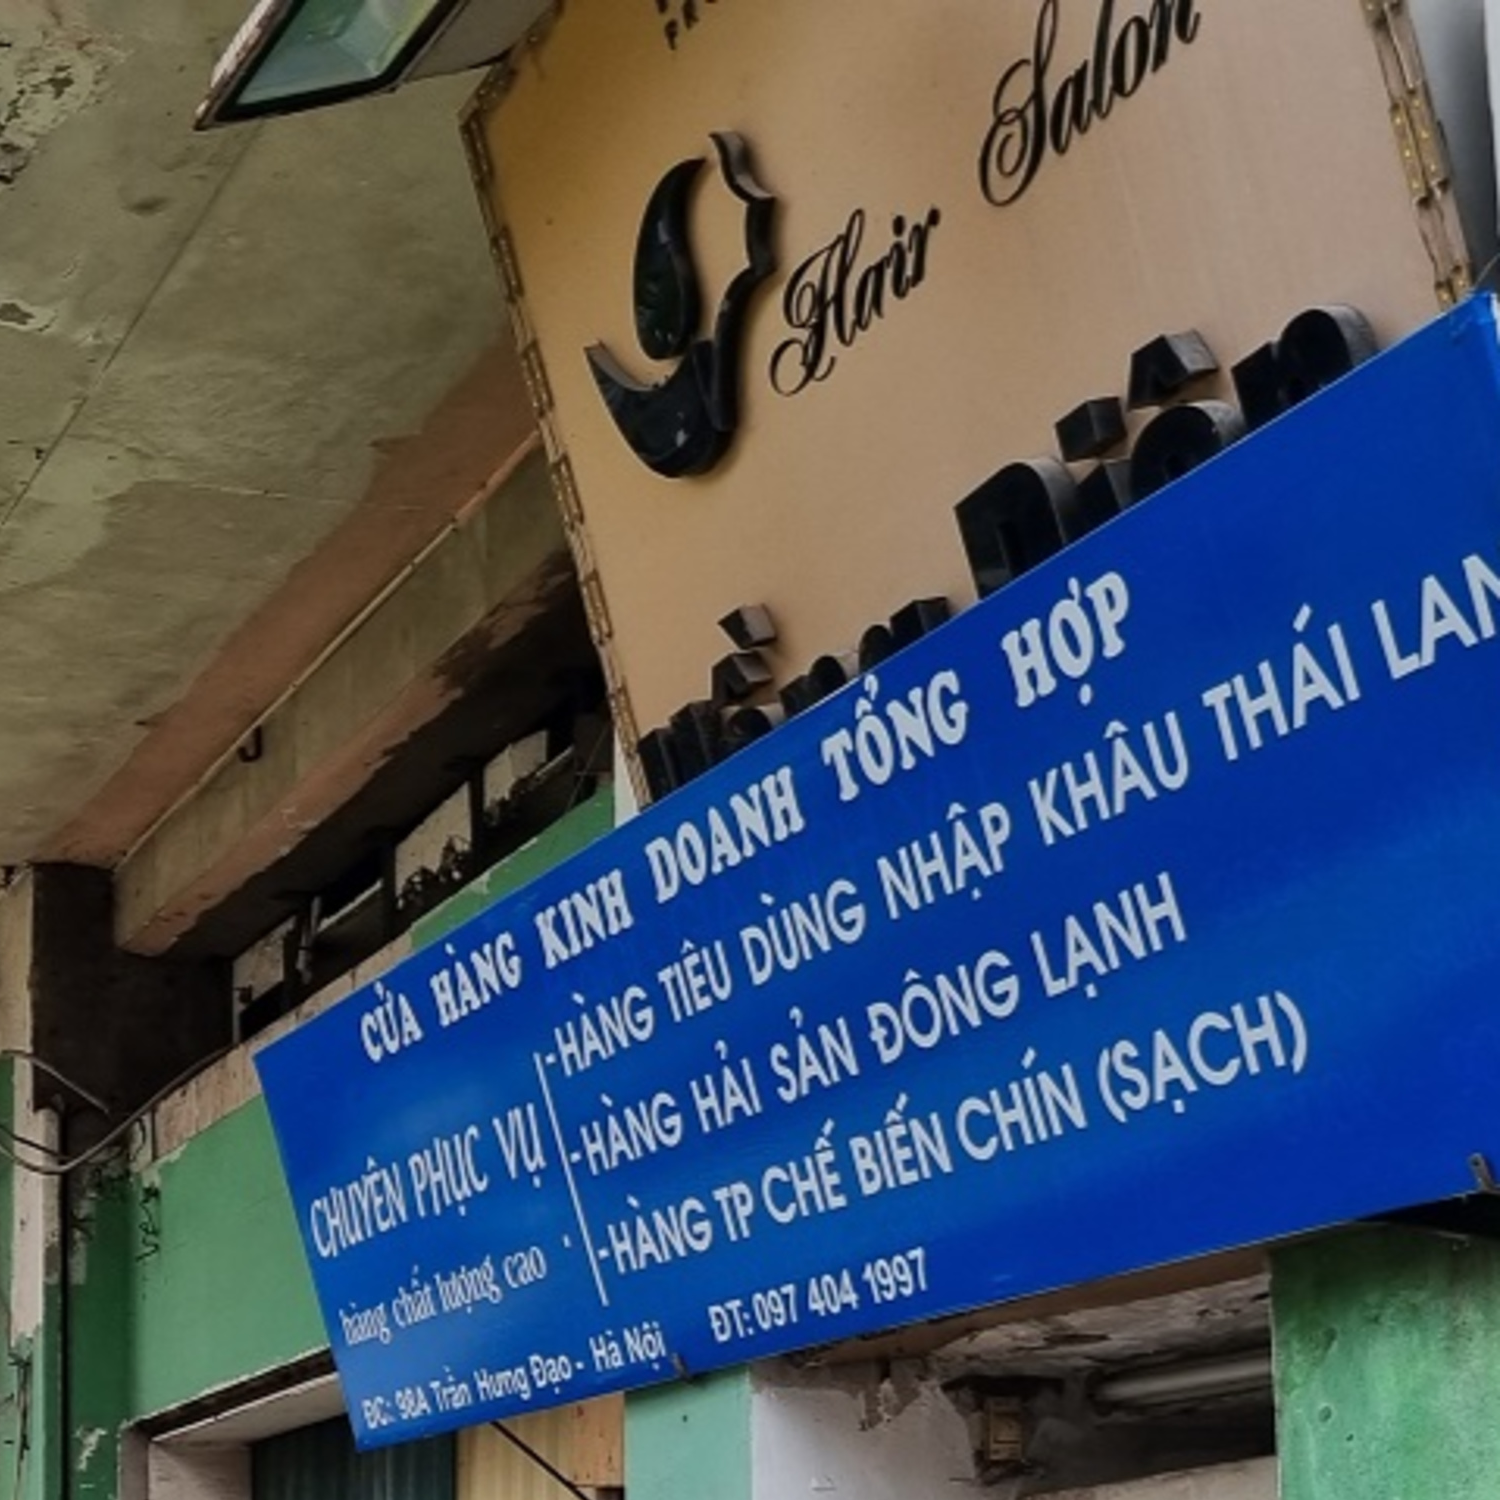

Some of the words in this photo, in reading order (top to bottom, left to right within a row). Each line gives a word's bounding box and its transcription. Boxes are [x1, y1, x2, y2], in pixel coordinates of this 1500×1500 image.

[768, 207, 941, 396] Hair
[978, 0, 1201, 207] Salon
[360, 982, 424, 1063] CỬA
[429, 932, 522, 1028] HÀNG
[534, 868, 634, 970] KINH
[644, 765, 806, 904] DOANH
[820, 669, 970, 802] TỔNG
[1000, 570, 1130, 708] HỢP
[657, 939, 733, 1023] TIÊU
[739, 878, 867, 986] DÙNG
[876, 801, 1011, 920] NHẬP
[1201, 603, 1361, 761] THÁI
[689, 1039, 763, 1134] HẢI
[769, 1006, 860, 1103] SẢN
[866, 948, 1020, 1065] ĐÔNG
[1030, 871, 1187, 999] LẠNH
[712, 1180, 755, 1242] TP
[760, 1118, 848, 1224] CHẾ
[848, 1092, 954, 1197] BIẾN
[955, 1047, 1088, 1161] CHÍN
[1097, 991, 1308, 1124] (SẠCH)
[310, 1155, 408, 1259] CHUYÊN
[407, 1124, 489, 1217] PHỤC
[491, 1102, 542, 1188] VỤ
[503, 1245, 548, 1289] cao
[707, 1298, 754, 1343] ĐT:
[752, 1282, 798, 1331] 097
[807, 1268, 859, 1317] 404
[861, 1246, 927, 1304] 1997
[394, 1384, 431, 1421] 98A
[473, 1366, 531, 1401] Hưng
[529, 1352, 573, 1395] Đạo
[588, 1328, 625, 1371] Hà
[622, 1320, 667, 1371] Nội
